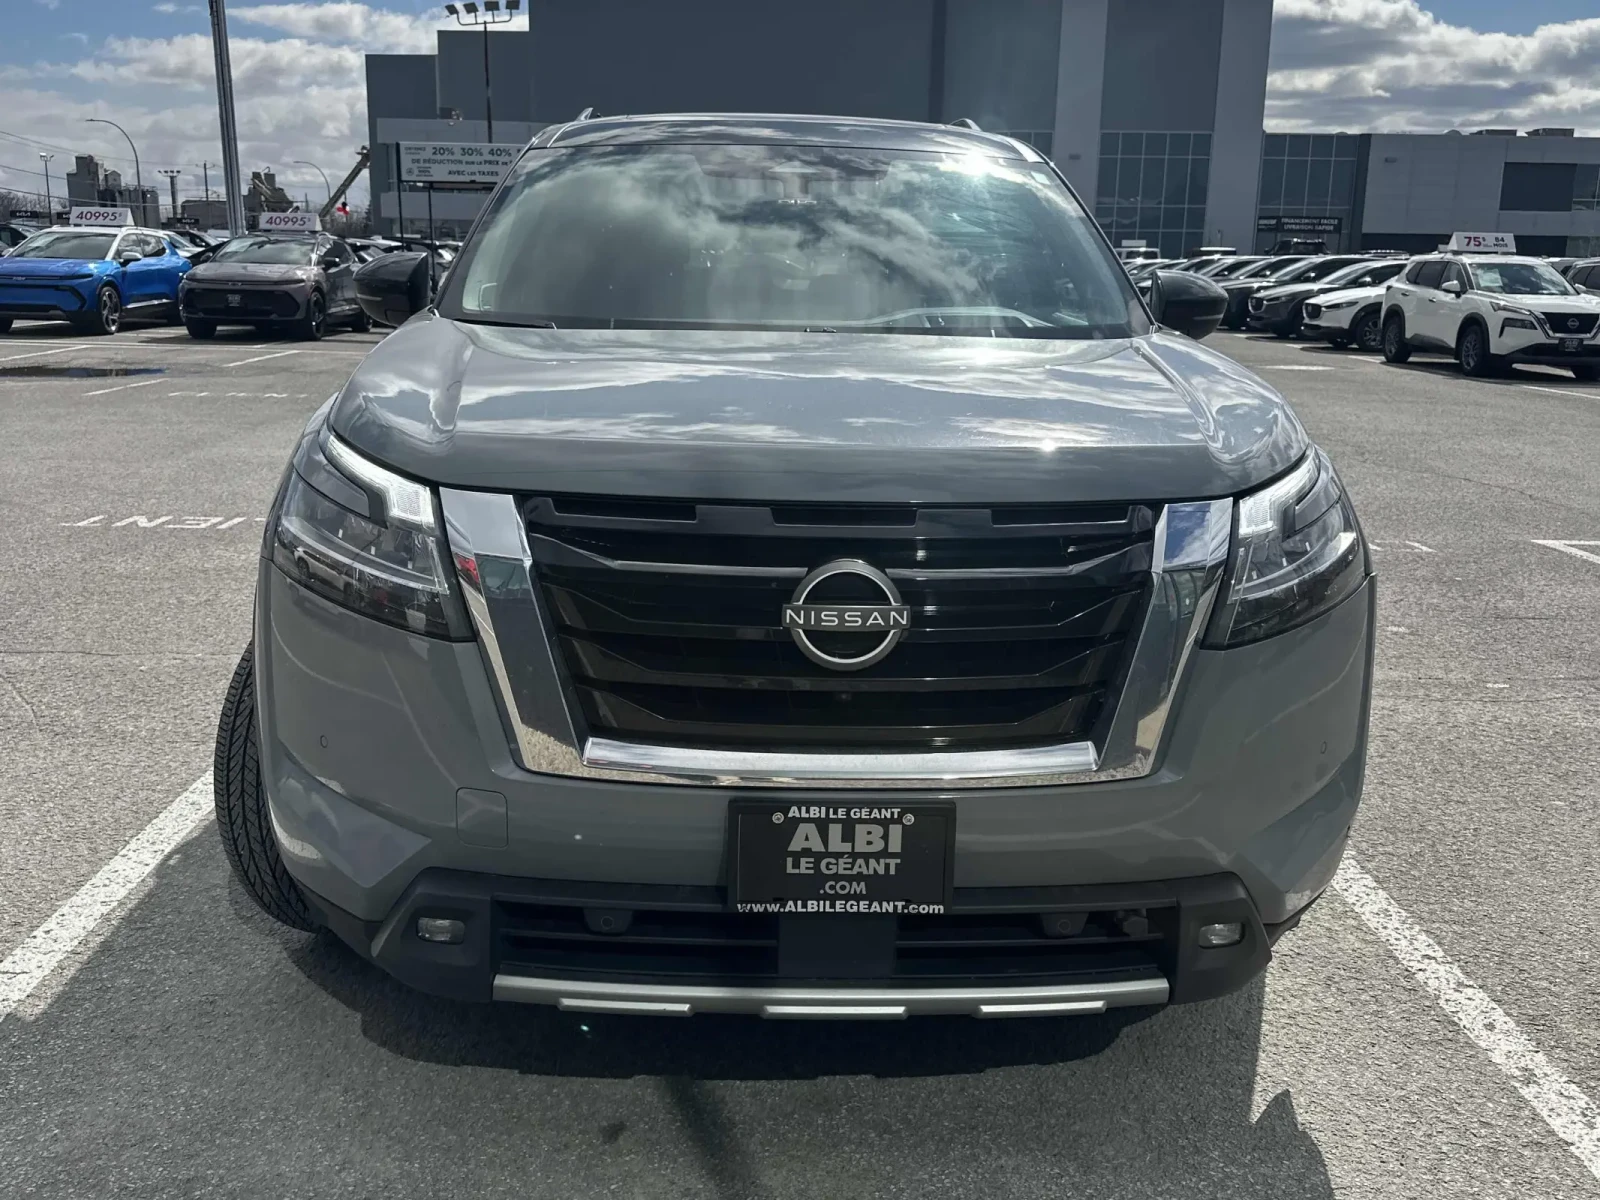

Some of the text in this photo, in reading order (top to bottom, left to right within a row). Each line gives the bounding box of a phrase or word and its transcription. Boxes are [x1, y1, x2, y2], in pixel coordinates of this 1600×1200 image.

[432, 147, 455, 156] 20%
[460, 147, 483, 157] 30%
[488, 148, 512, 157] 40%
[422, 157, 464, 165] RÉDUCTION
[785, 609, 908, 626] NISSAN
[788, 806, 901, 819] ALBI LE GÉANT
[787, 822, 903, 853] ALBI
[786, 854, 901, 875] LE GÉANT
[819, 880, 867, 895] .COM
[736, 900, 945, 914] www.ALBILEGEANT.com
